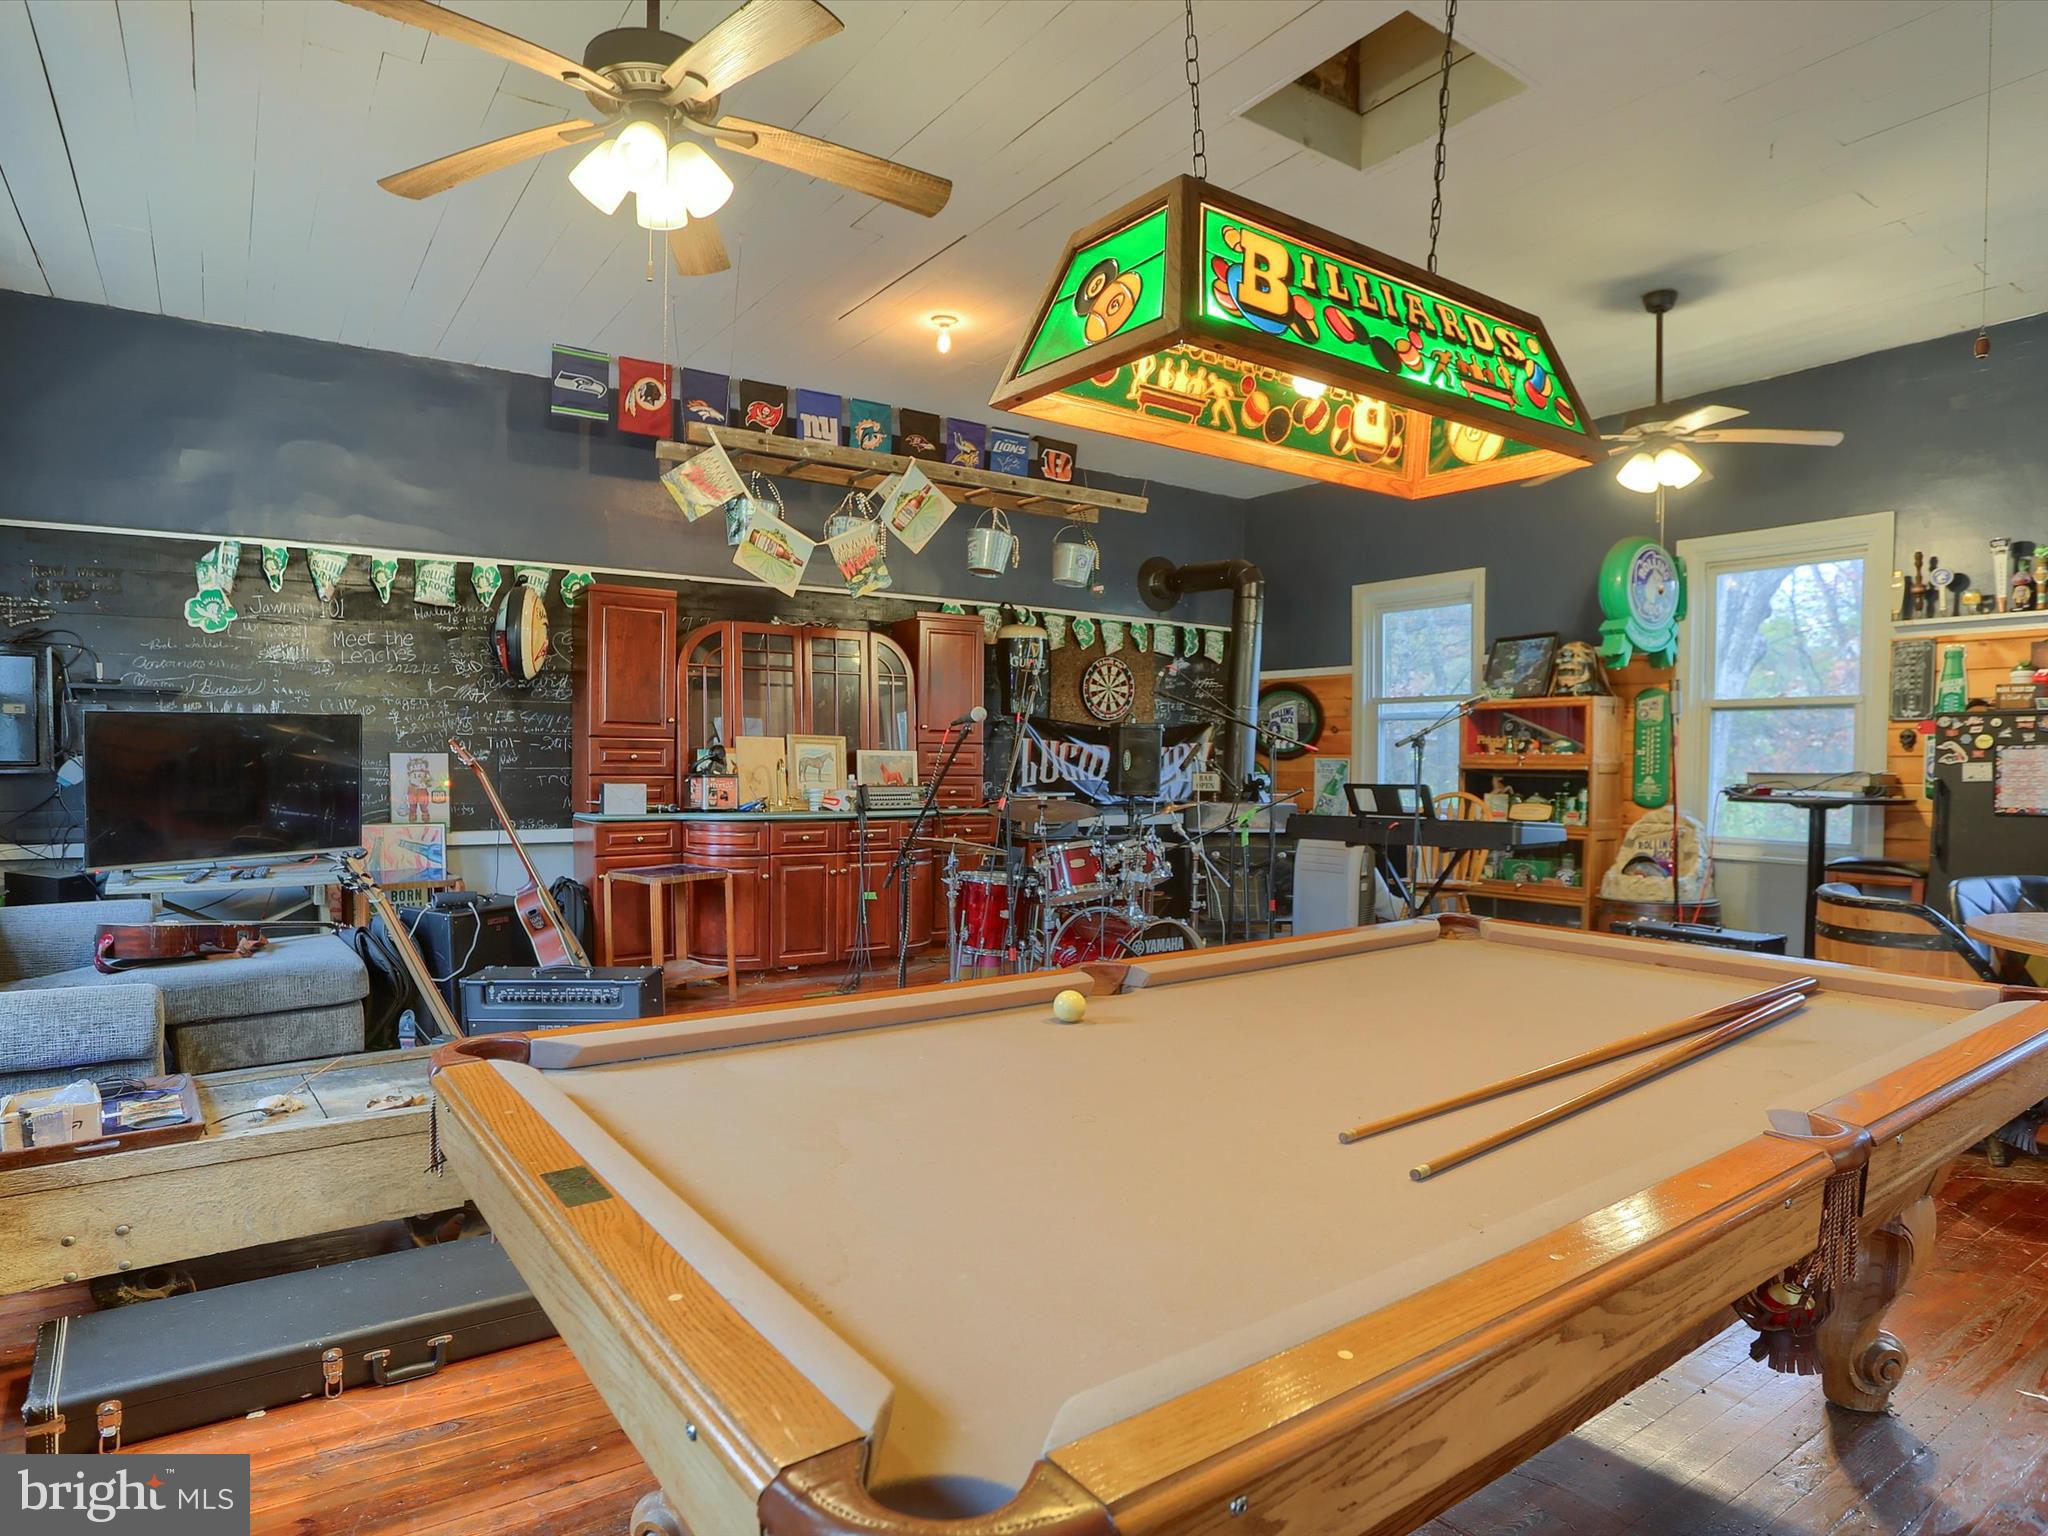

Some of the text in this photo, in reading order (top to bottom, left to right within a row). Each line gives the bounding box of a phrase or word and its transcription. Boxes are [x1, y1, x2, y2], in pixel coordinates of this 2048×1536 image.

[1239, 228, 1527, 363] BILLIARDS
[992, 440, 1027, 455] LIONS
[421, 569, 455, 586] ROLLING
[319, 598, 345, 618] 101
[333, 628, 415, 648] Meet the
[341, 645, 418, 665] Leaches
[385, 661, 441, 675] 2022/23
[1271, 707, 1295, 719] ROLLING
[391, 888, 422, 902] BORN
[1145, 936, 1185, 953] YAMAHA
